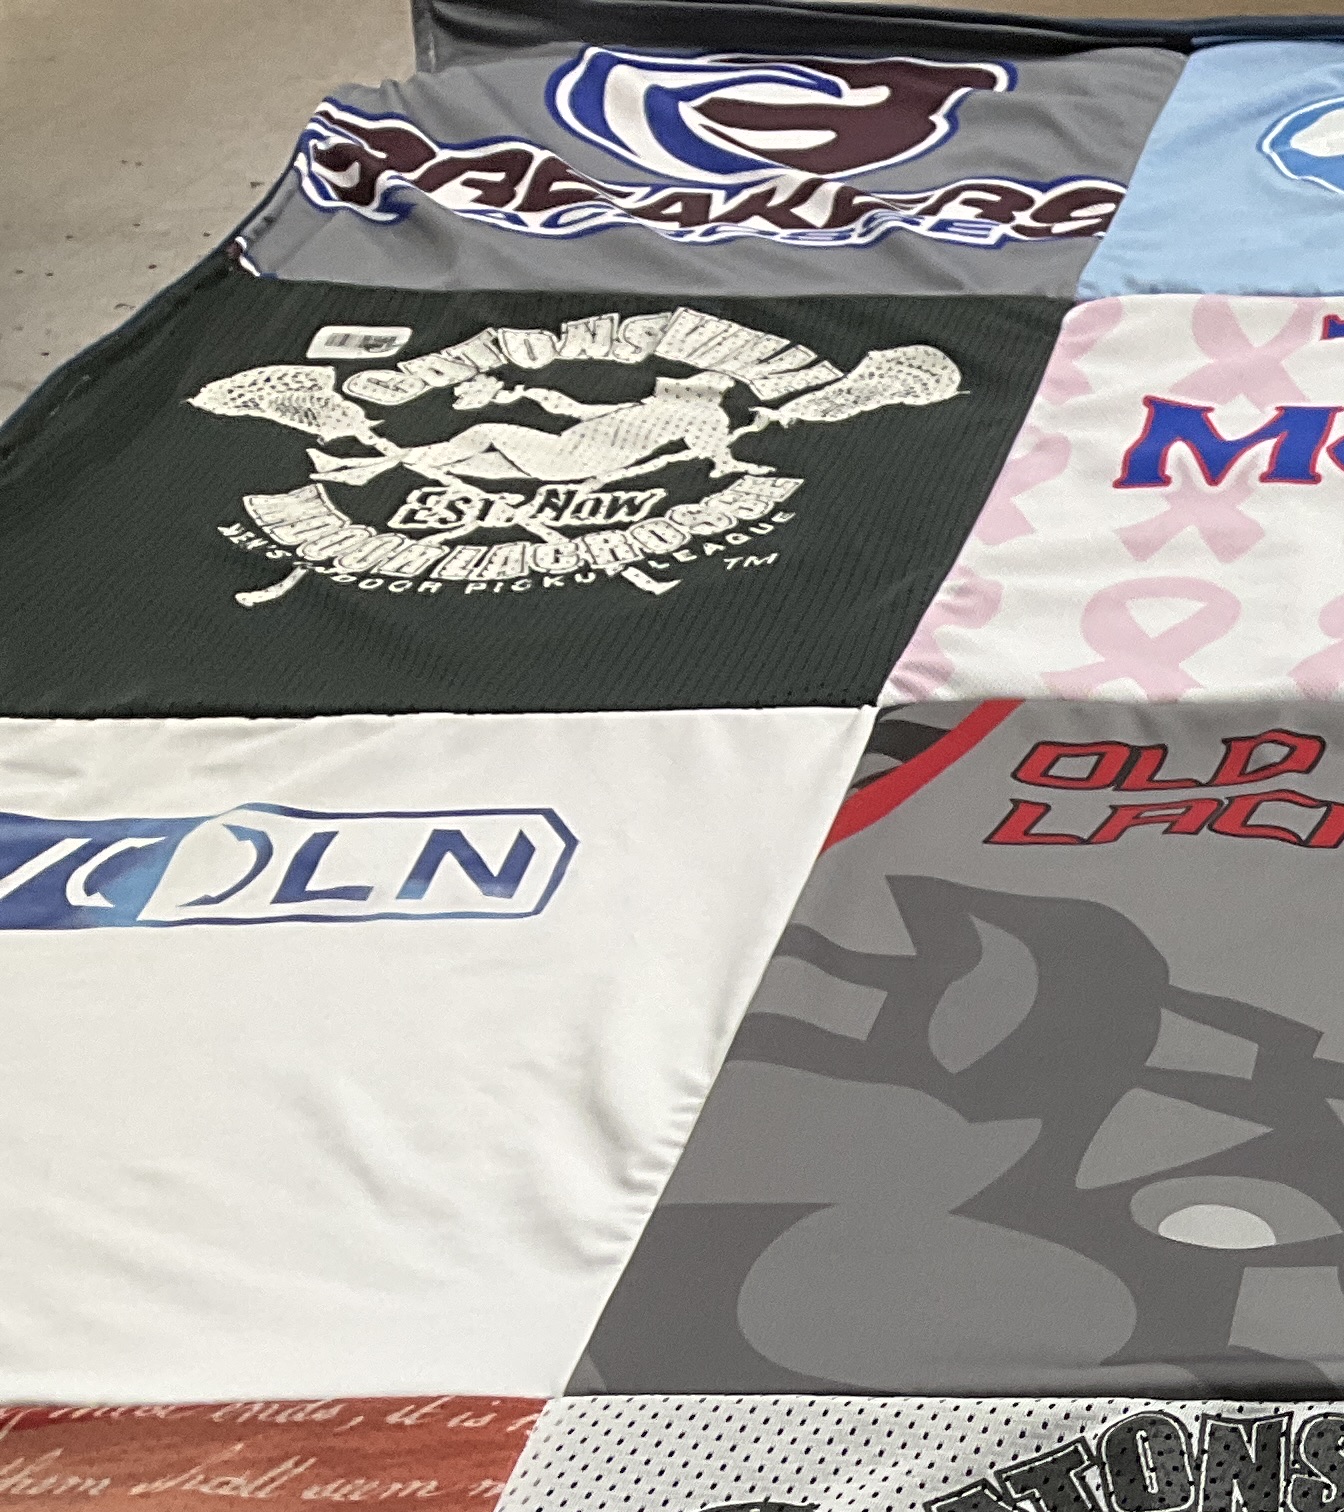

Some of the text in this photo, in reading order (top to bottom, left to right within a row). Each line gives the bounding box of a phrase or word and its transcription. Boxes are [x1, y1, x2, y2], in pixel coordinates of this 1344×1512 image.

[649, 510, 798, 570] LEAGUE
[723, 551, 780, 571] TM
[1010, 729, 1328, 793] OLD
